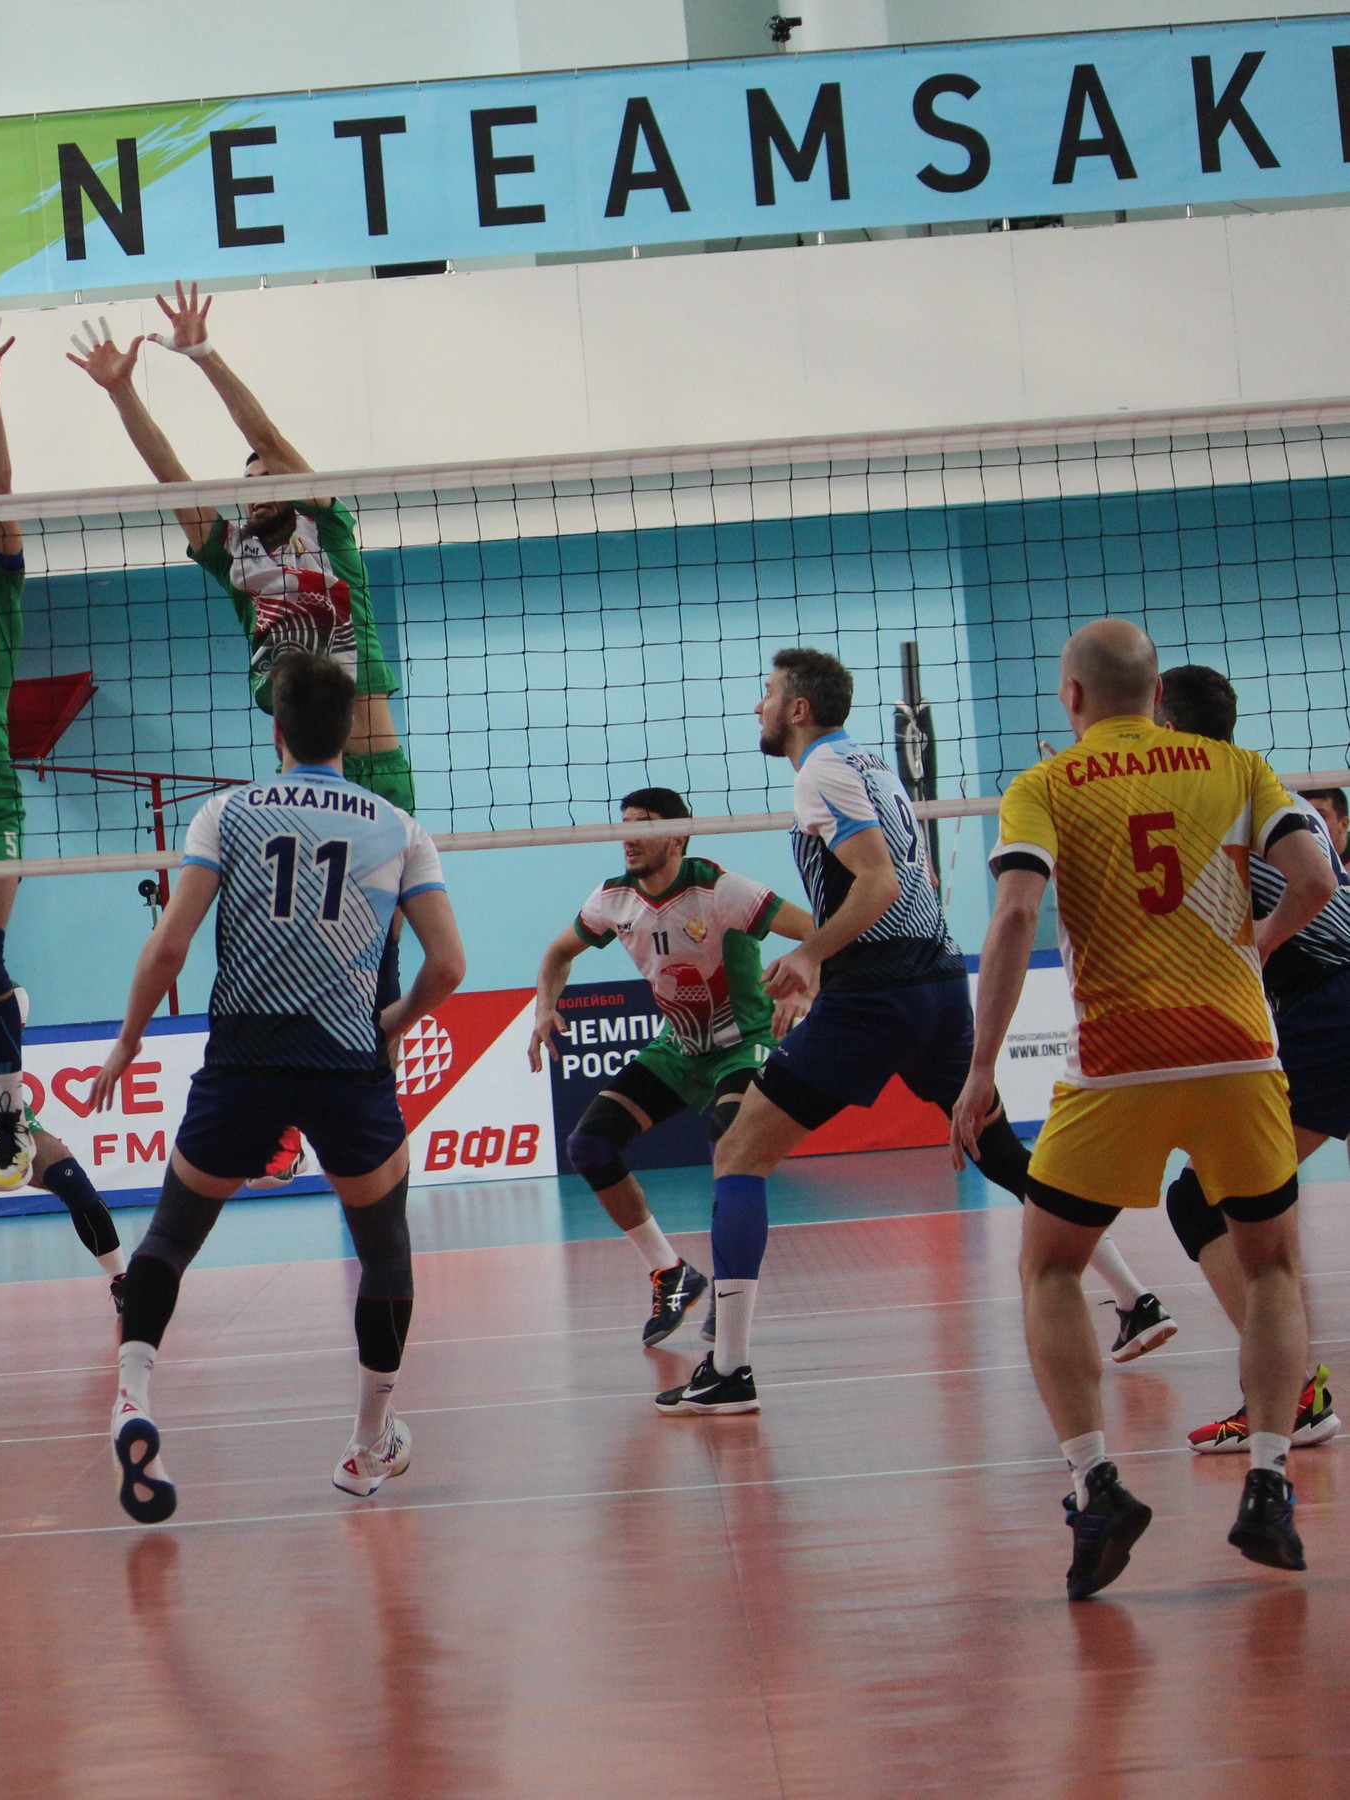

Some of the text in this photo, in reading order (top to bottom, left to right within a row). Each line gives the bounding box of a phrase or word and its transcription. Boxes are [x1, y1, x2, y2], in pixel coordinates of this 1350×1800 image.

[1065, 746, 1211, 787] САХАЛИН
[248, 786, 376, 821] САХАЛИН
[4, 830, 17, 858] 5
[893, 794, 918, 863] 9
[265, 835, 348, 921] 11
[1128, 811, 1185, 915] 5
[651, 931, 670, 955] 11
[558, 993, 625, 1009] ВОЛЕЙБОЛ
[1009, 1042, 1072, 1059] WWW.ONET
[93, 1130, 166, 1166] FM
[424, 1124, 540, 1172] ВФВ
